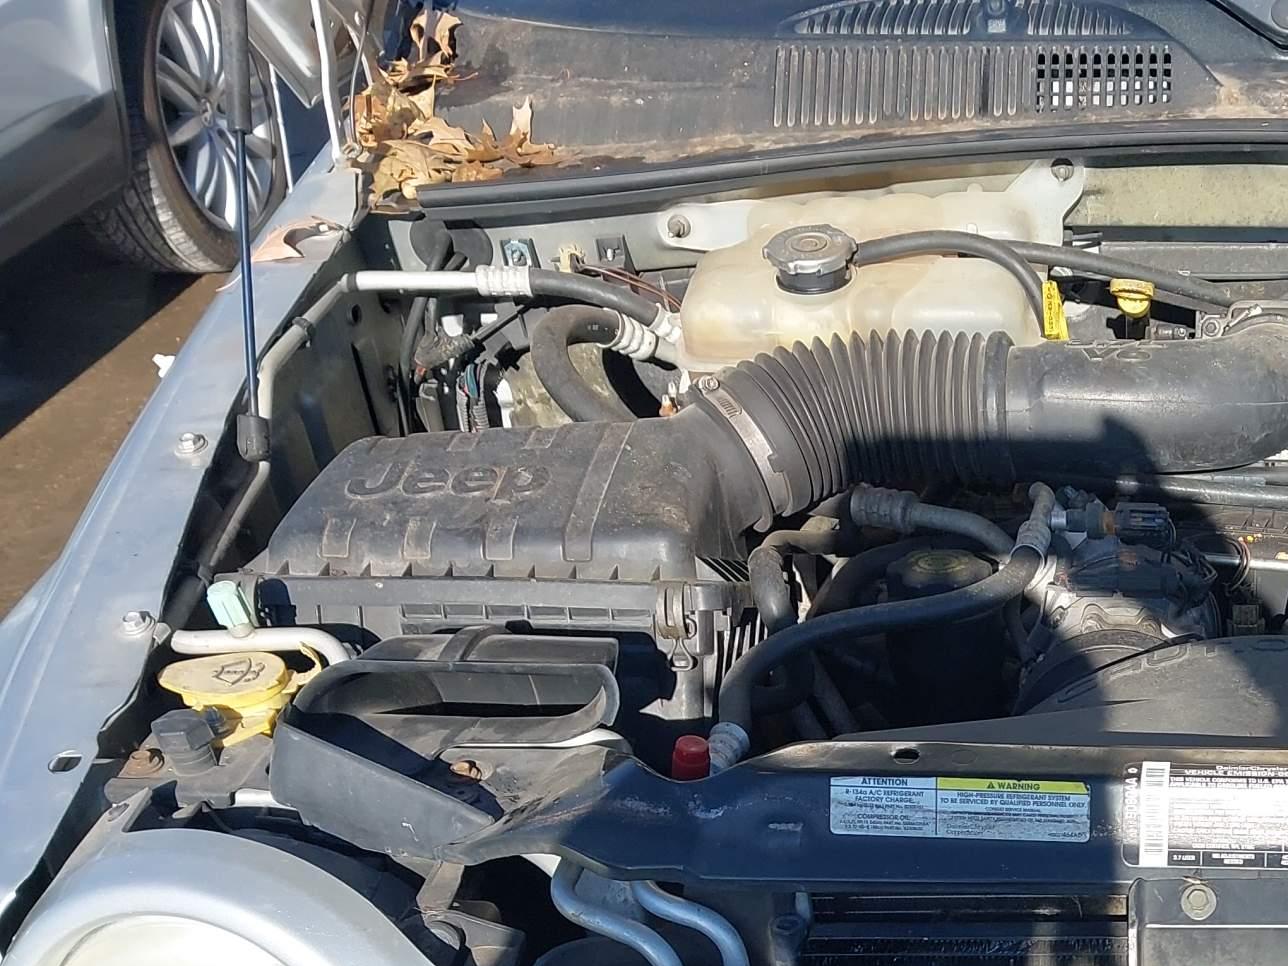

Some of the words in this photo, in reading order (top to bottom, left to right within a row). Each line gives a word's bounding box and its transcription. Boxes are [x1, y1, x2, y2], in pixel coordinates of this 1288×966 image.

[345, 462, 552, 504] Jeep
[861, 777, 908, 786] ATTENTION
[998, 782, 1041, 791] WARNING
[1006, 793, 1046, 801] REFRIGERANT
[999, 799, 1031, 807] QUALIFIED
